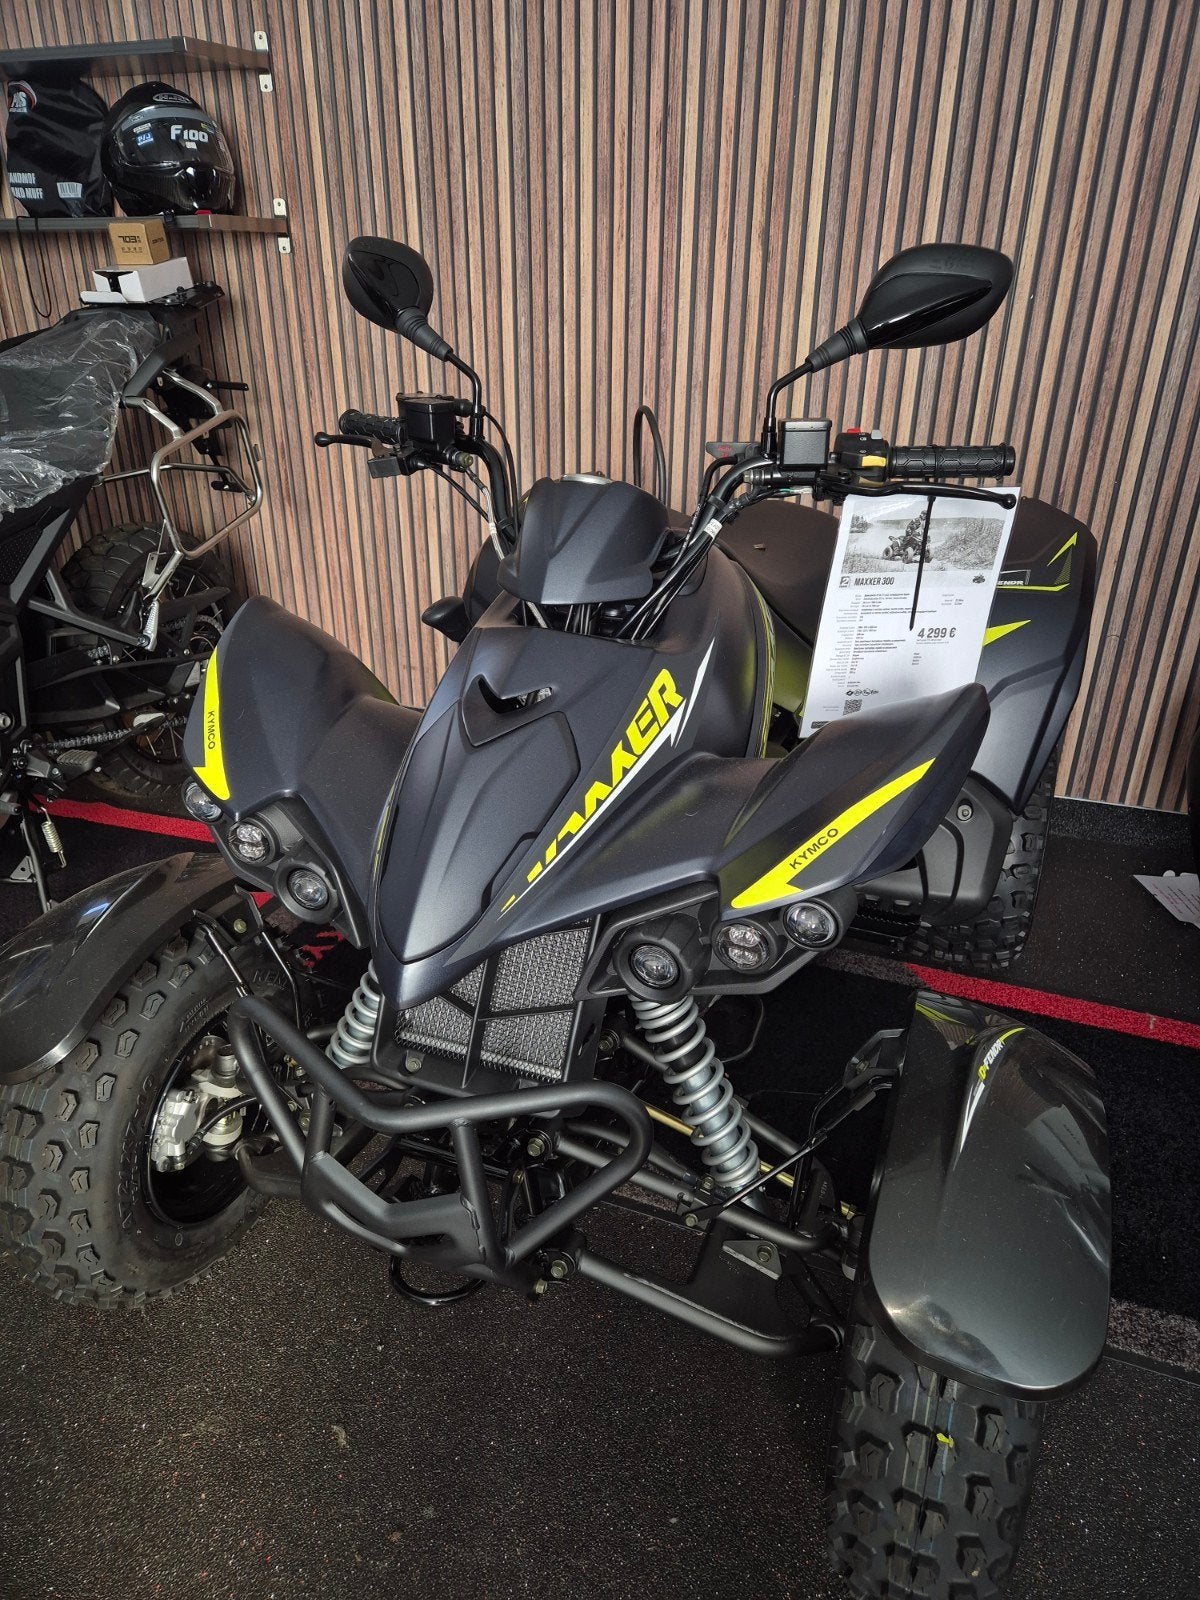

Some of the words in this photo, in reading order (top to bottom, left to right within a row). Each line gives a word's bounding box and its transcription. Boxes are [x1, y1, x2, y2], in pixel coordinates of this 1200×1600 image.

[854, 577, 882, 586] MAXXER
[881, 577, 895, 585] 300
[208, 711, 216, 749] KYMCO
[789, 827, 840, 870] KYMCO
